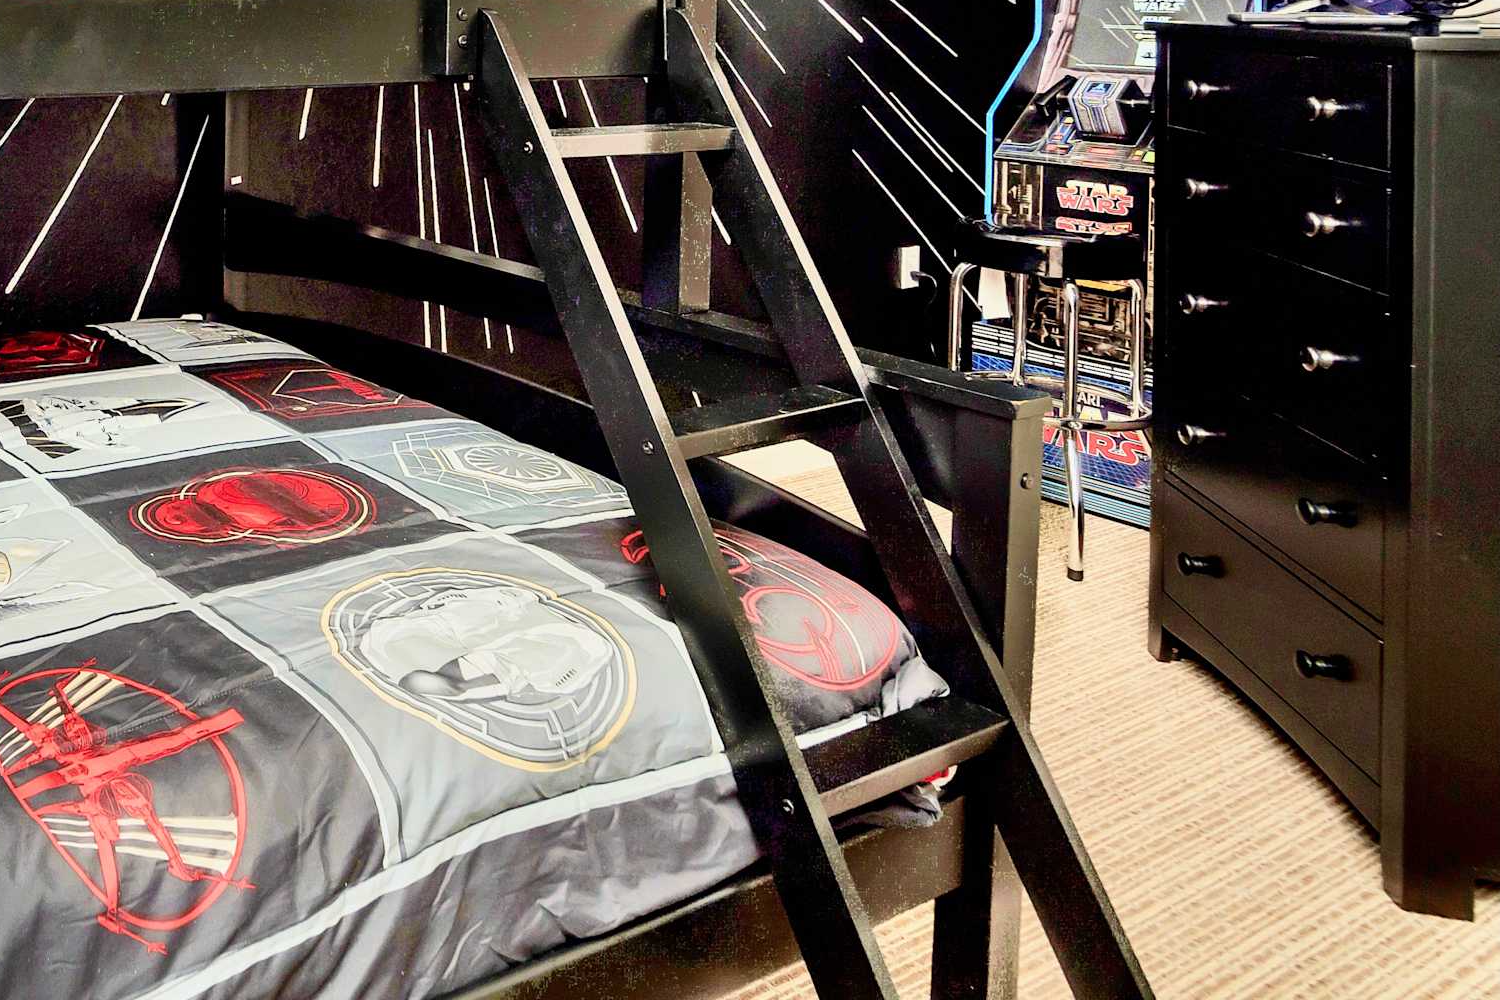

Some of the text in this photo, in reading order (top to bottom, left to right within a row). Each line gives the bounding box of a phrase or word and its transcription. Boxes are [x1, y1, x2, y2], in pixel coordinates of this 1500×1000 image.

[1133, 1, 1187, 13] WARS
[1057, 180, 1130, 200] STAR
[1057, 186, 1134, 216] WARS
